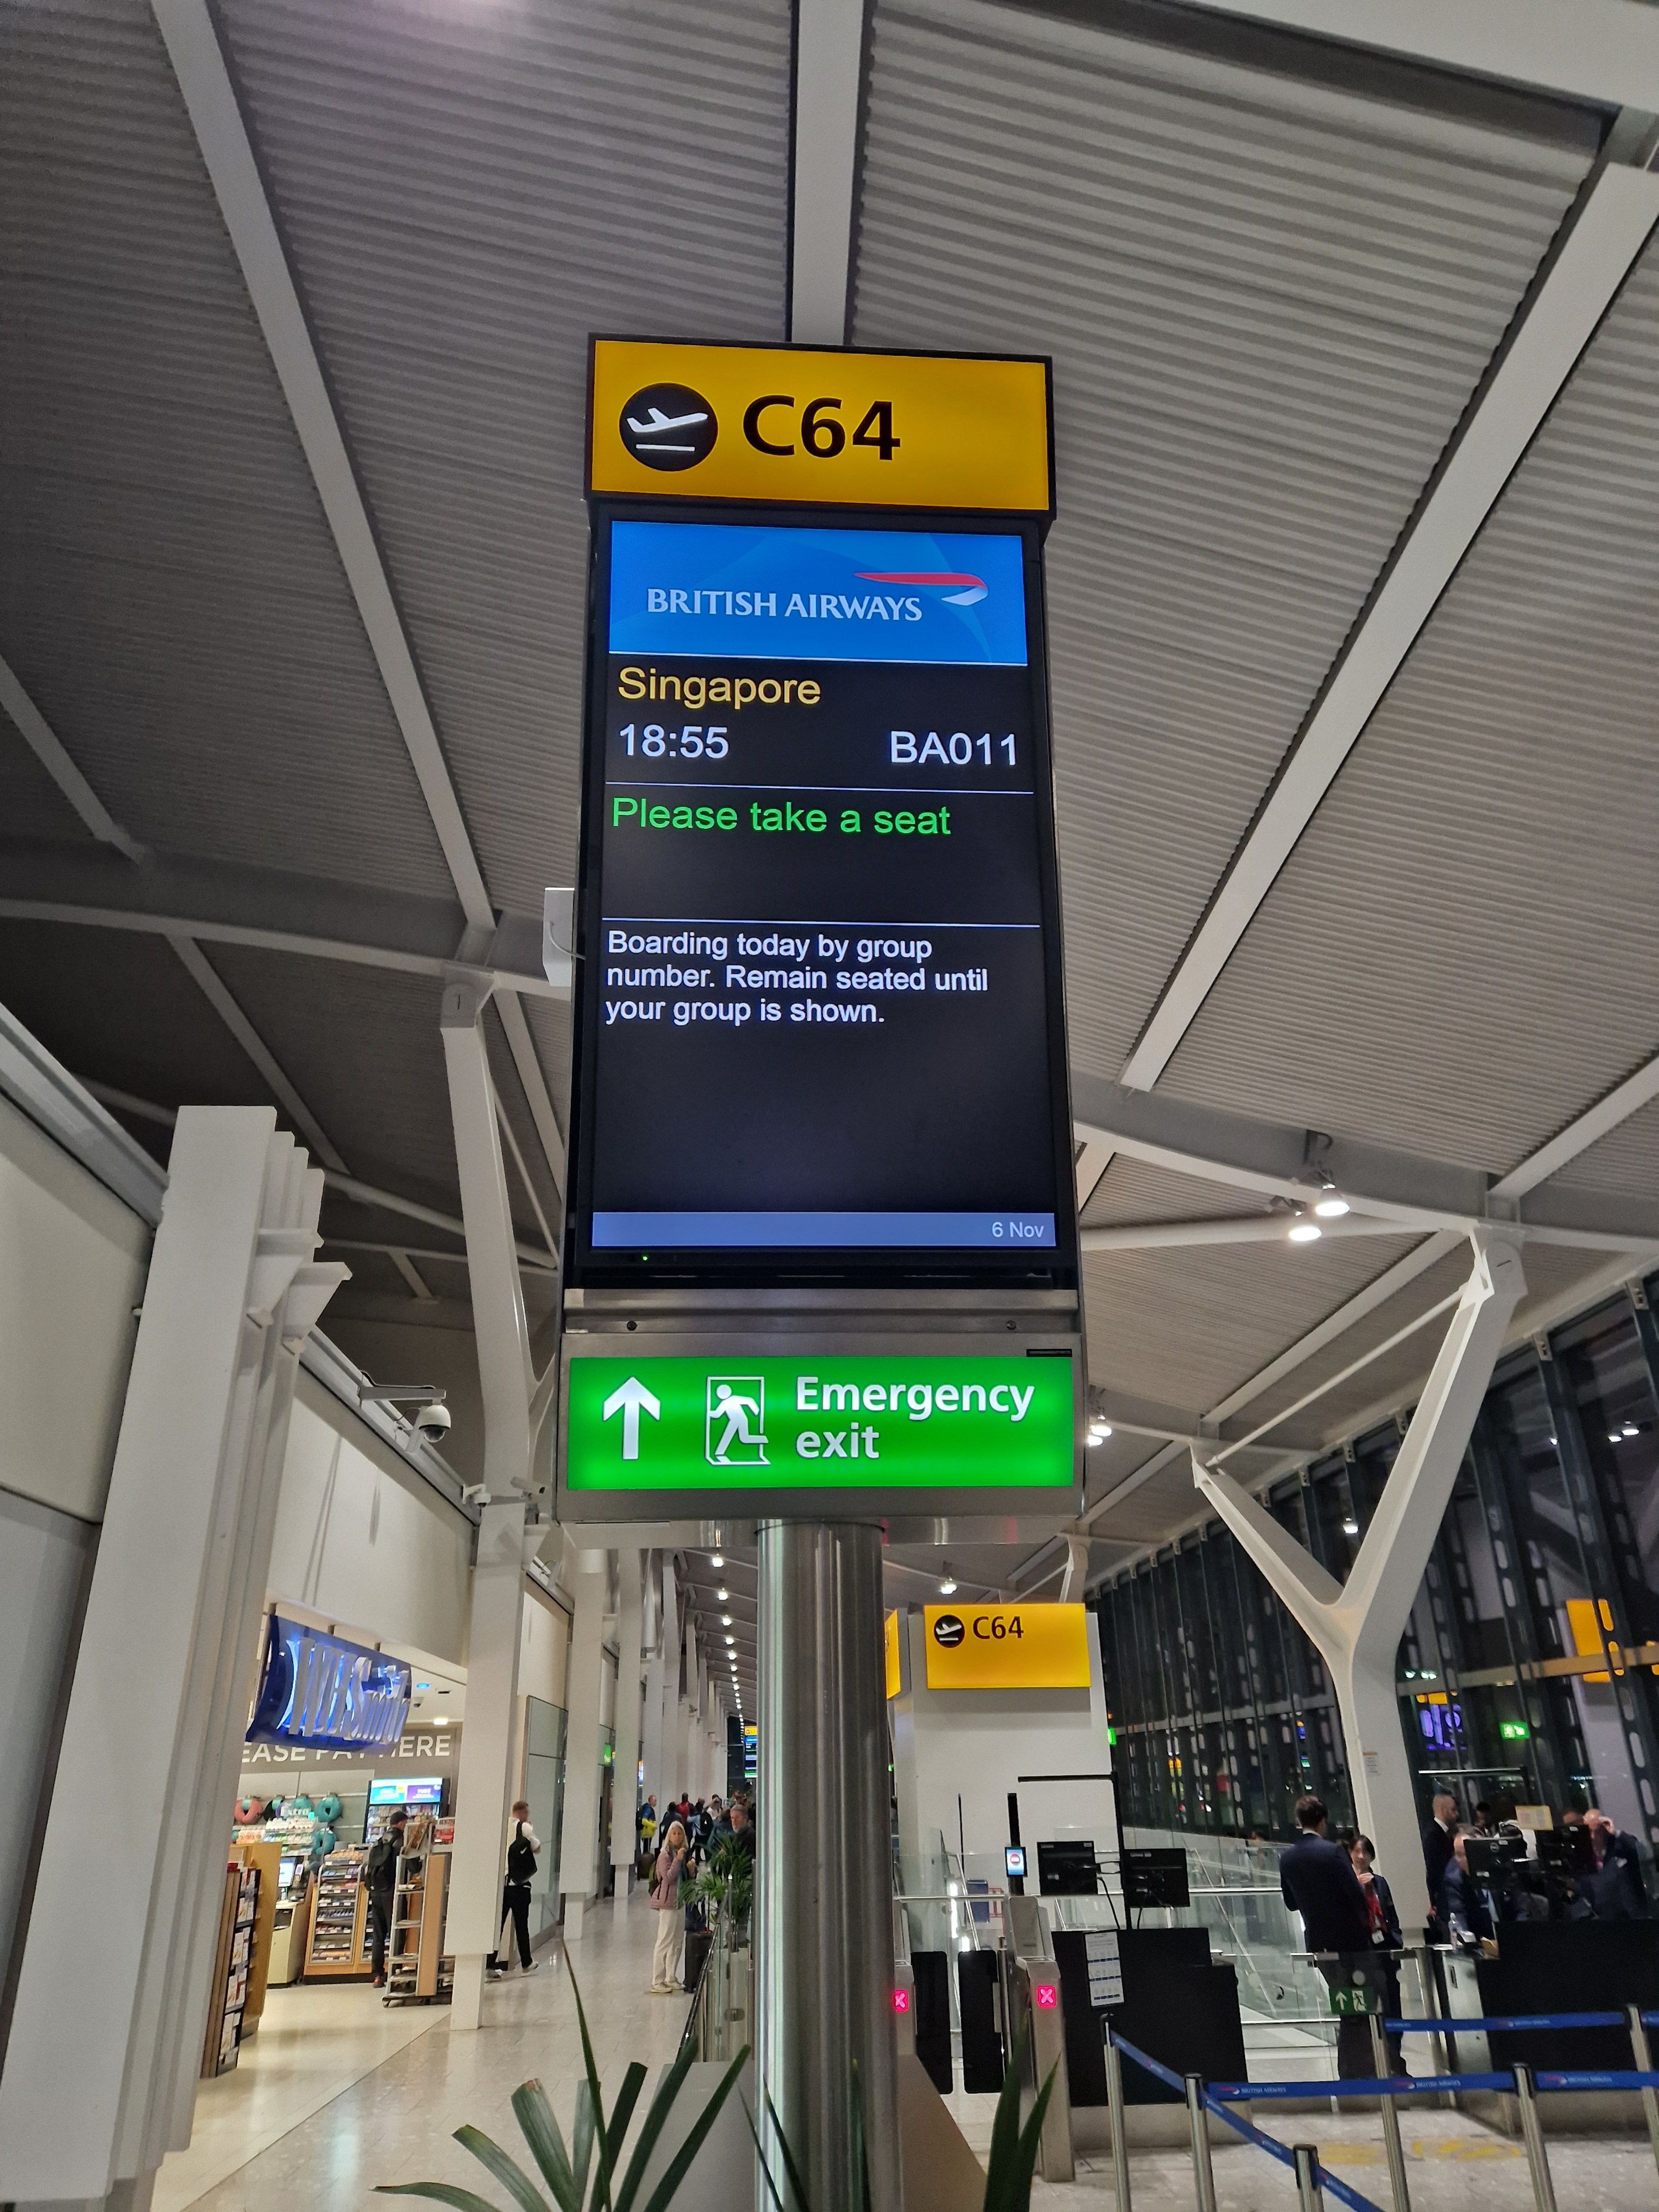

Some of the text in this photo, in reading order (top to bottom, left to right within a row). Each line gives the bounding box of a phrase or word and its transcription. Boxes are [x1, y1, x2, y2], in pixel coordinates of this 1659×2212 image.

[743, 395, 900, 460] C64
[648, 589, 922, 620] BRITISH AIRWAYS
[619, 667, 820, 709] Singapore
[620, 724, 728, 758] 18:55
[891, 731, 1015, 765] BA011
[613, 797, 951, 834] Please take a seat
[609, 931, 932, 963] Boarding today by group
[608, 964, 987, 990] number. Remain seated until
[606, 998, 884, 1026] your group is shown.
[993, 1222, 1044, 1237] 6 Nov
[797, 1377, 1035, 1421] Emergency
[797, 1422, 879, 1458] exit
[973, 1616, 1024, 1639] C64
[242, 1742, 306, 1763] EASE
